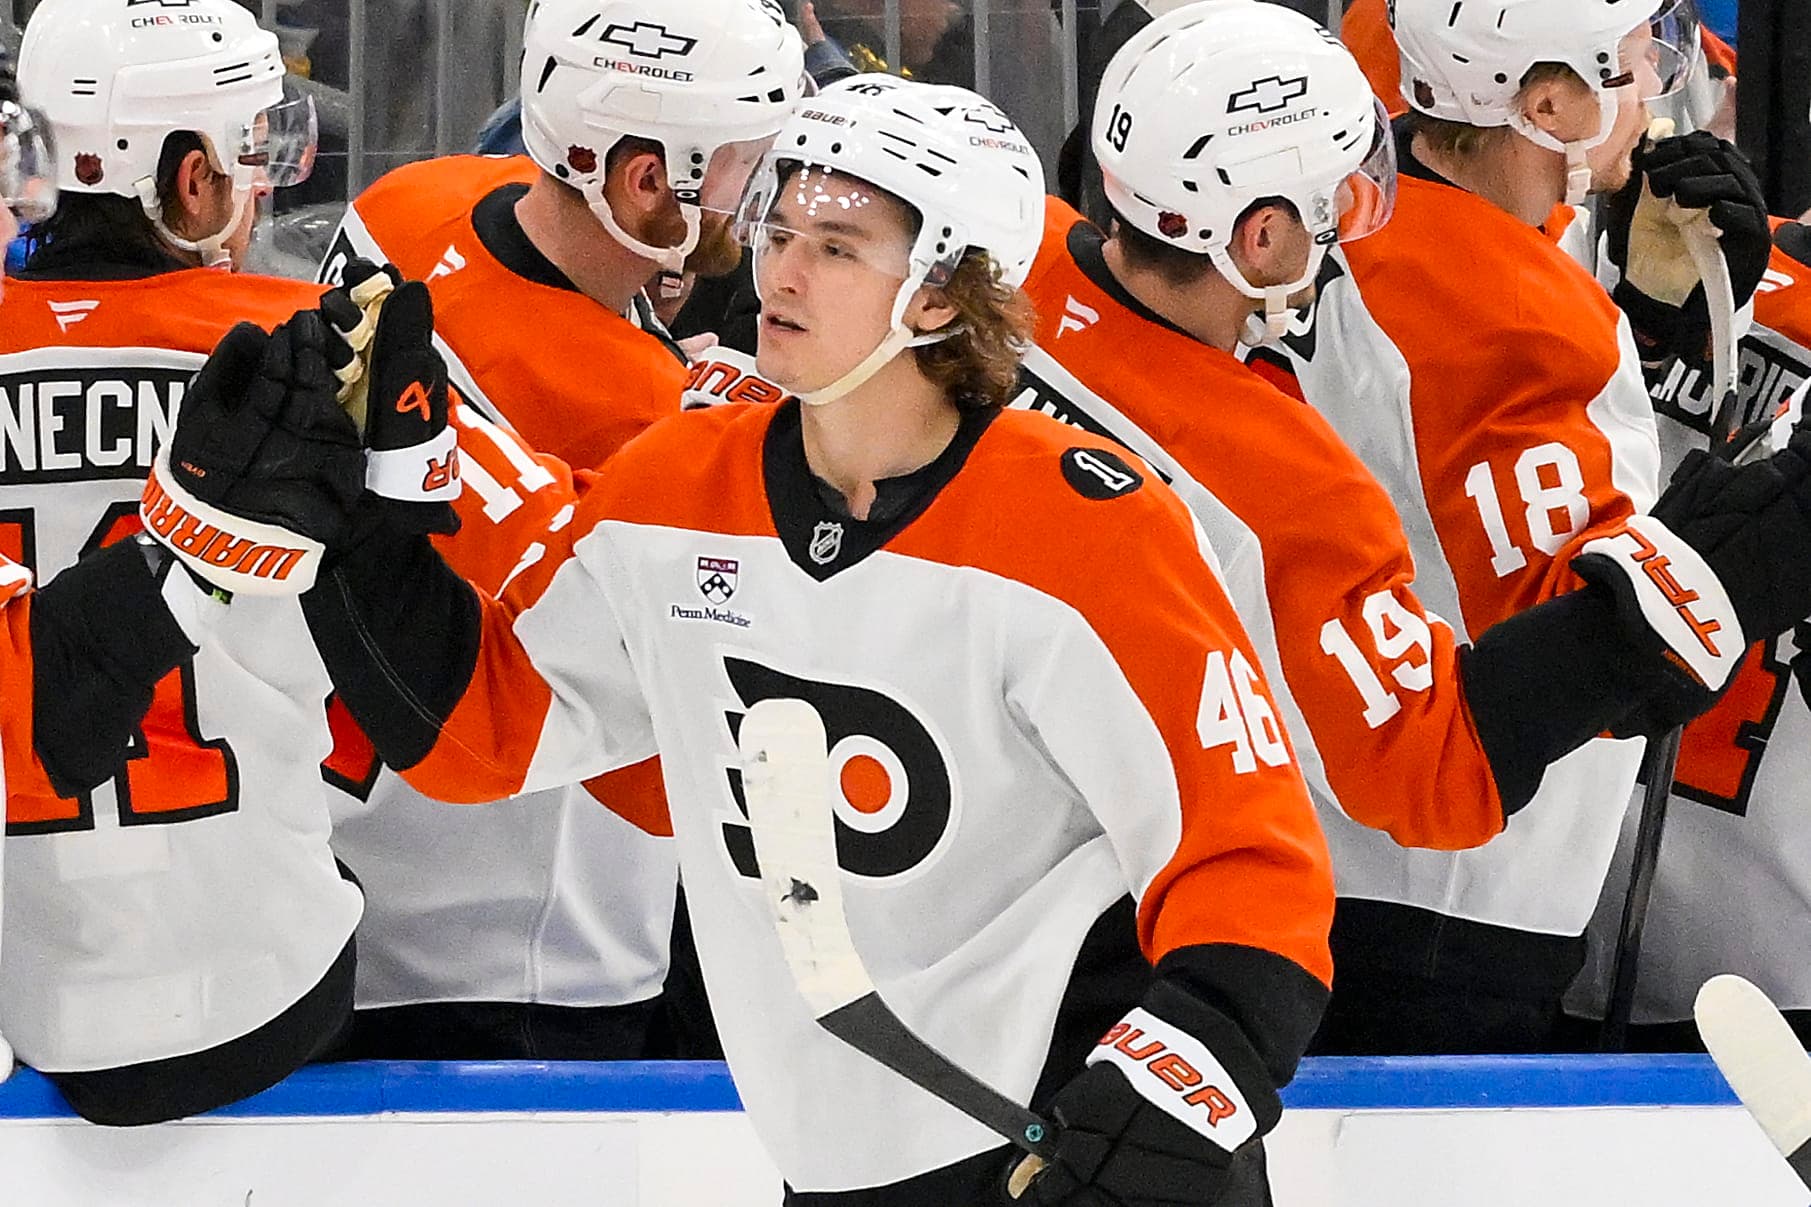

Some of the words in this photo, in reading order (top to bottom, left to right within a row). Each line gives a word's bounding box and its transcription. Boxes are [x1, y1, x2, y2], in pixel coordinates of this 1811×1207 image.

[131, 15, 223, 28] CHEROL
[593, 57, 694, 82] CHEVROLET
[1106, 103, 1132, 153] 19
[1228, 108, 1317, 136] CHEVROLET
[1074, 450, 1136, 492] 1
[141, 470, 310, 581] WARRI
[1464, 442, 1590, 578] 18
[671, 604, 703, 619] Penn
[704, 606, 751, 628] Medicine
[1320, 589, 1433, 729] 19
[1195, 647, 1291, 774] 46
